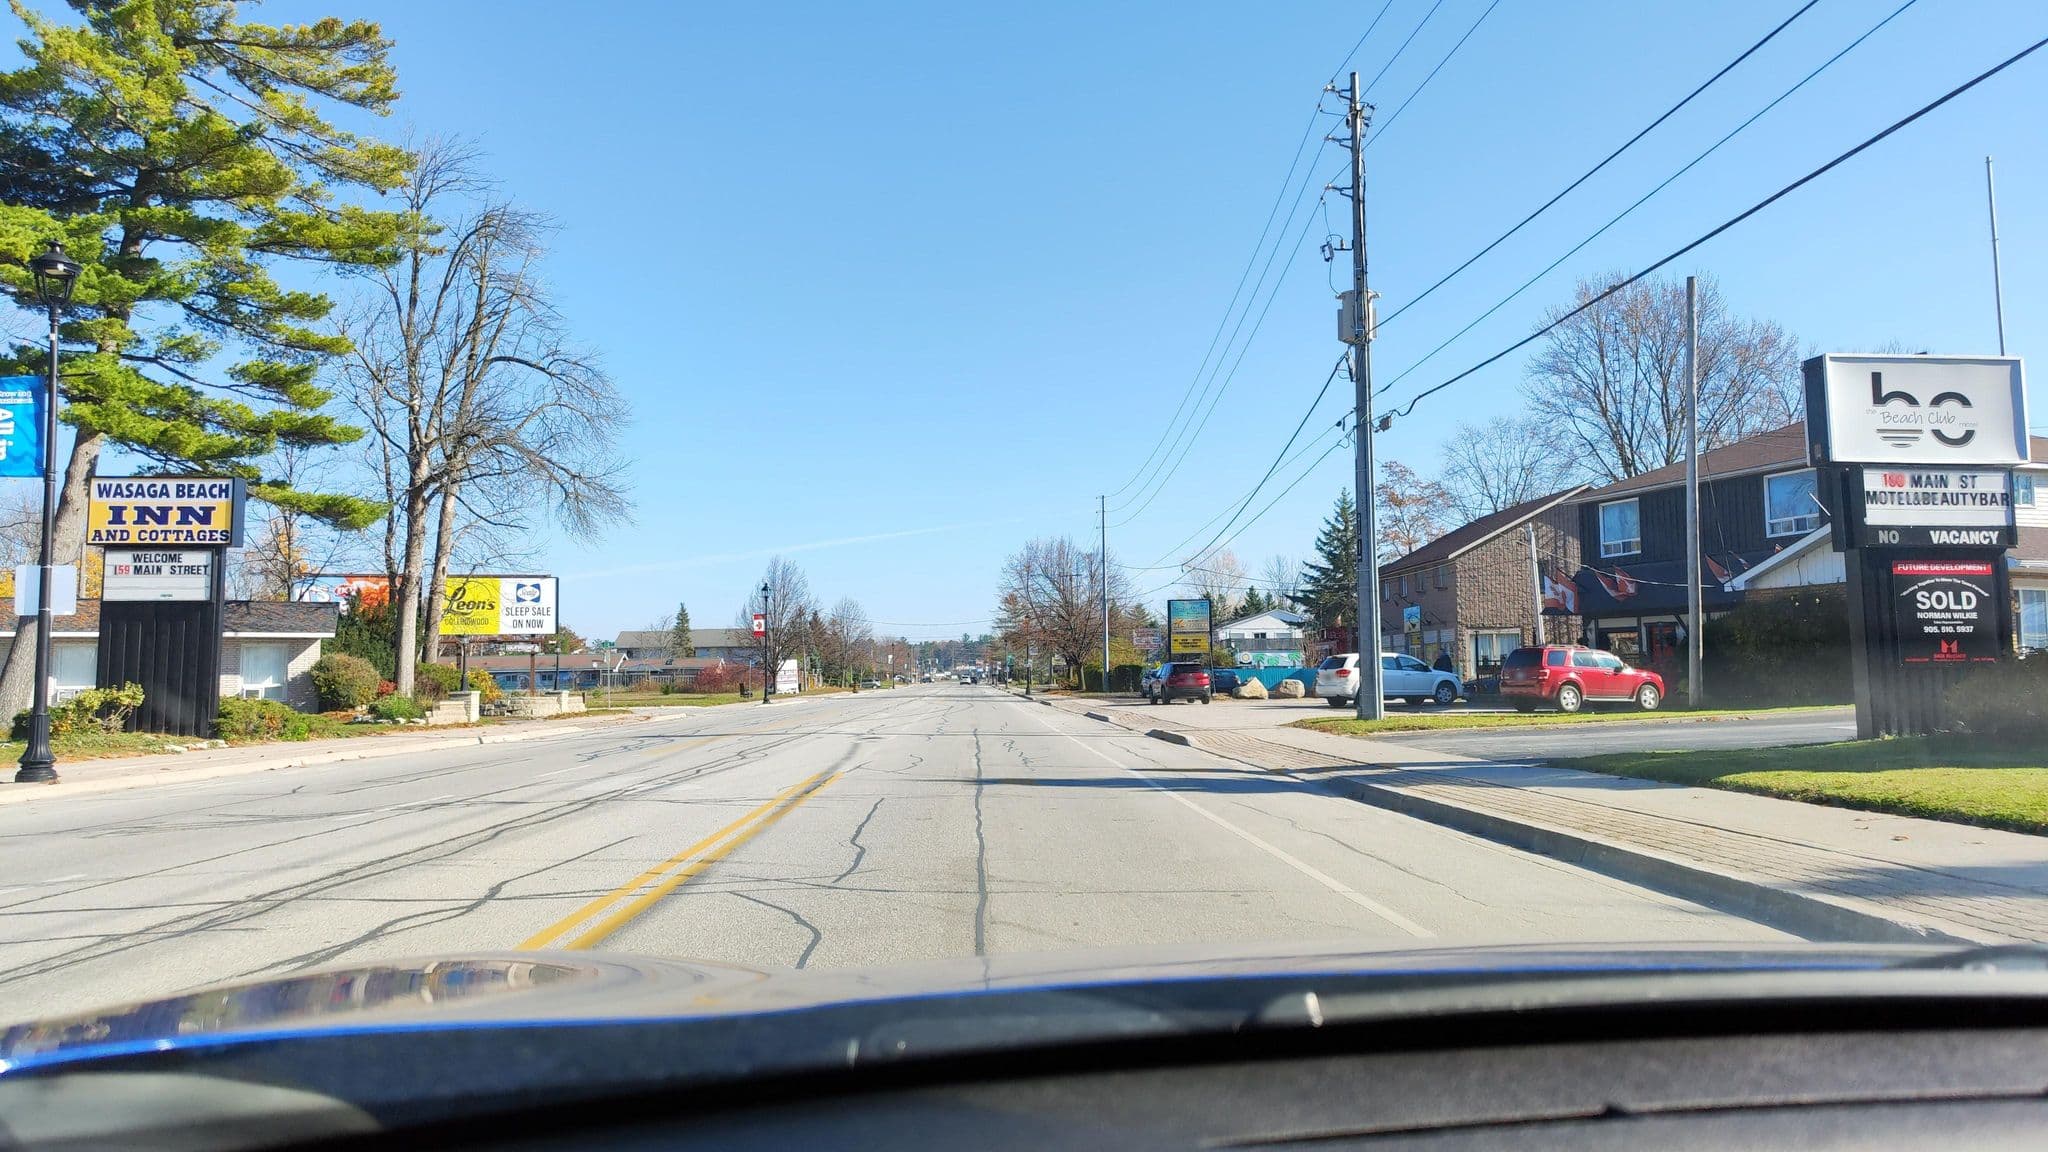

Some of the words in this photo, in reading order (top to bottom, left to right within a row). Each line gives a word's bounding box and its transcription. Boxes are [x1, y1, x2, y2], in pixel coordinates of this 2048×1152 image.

[1880, 411, 1923, 425] Beach
[1927, 411, 1956, 425] Club
[1910, 474, 1949, 488] MAIN
[1960, 475, 1978, 489] ST
[97, 483, 170, 499] WASAGA
[176, 483, 230, 499] BEACH
[107, 505, 217, 526] INN
[91, 529, 131, 542] AND
[138, 529, 230, 542] COTTAGES
[1878, 530, 1900, 544] NO
[1929, 530, 2000, 545] VACANCY
[133, 553, 183, 565] WELCOME
[114, 565, 130, 576] 159
[134, 565, 162, 576] MAIN
[170, 565, 209, 576] STREET
[1897, 563, 1930, 571] FUTURE
[1930, 563, 1987, 571] DEVELOPMENT
[442, 586, 496, 615] Leon's
[1915, 590, 1977, 610] SOLD
[505, 607, 530, 616] SLEEP
[531, 606, 552, 616] SALE
[512, 619, 524, 629] ON
[525, 619, 545, 629] NOW
